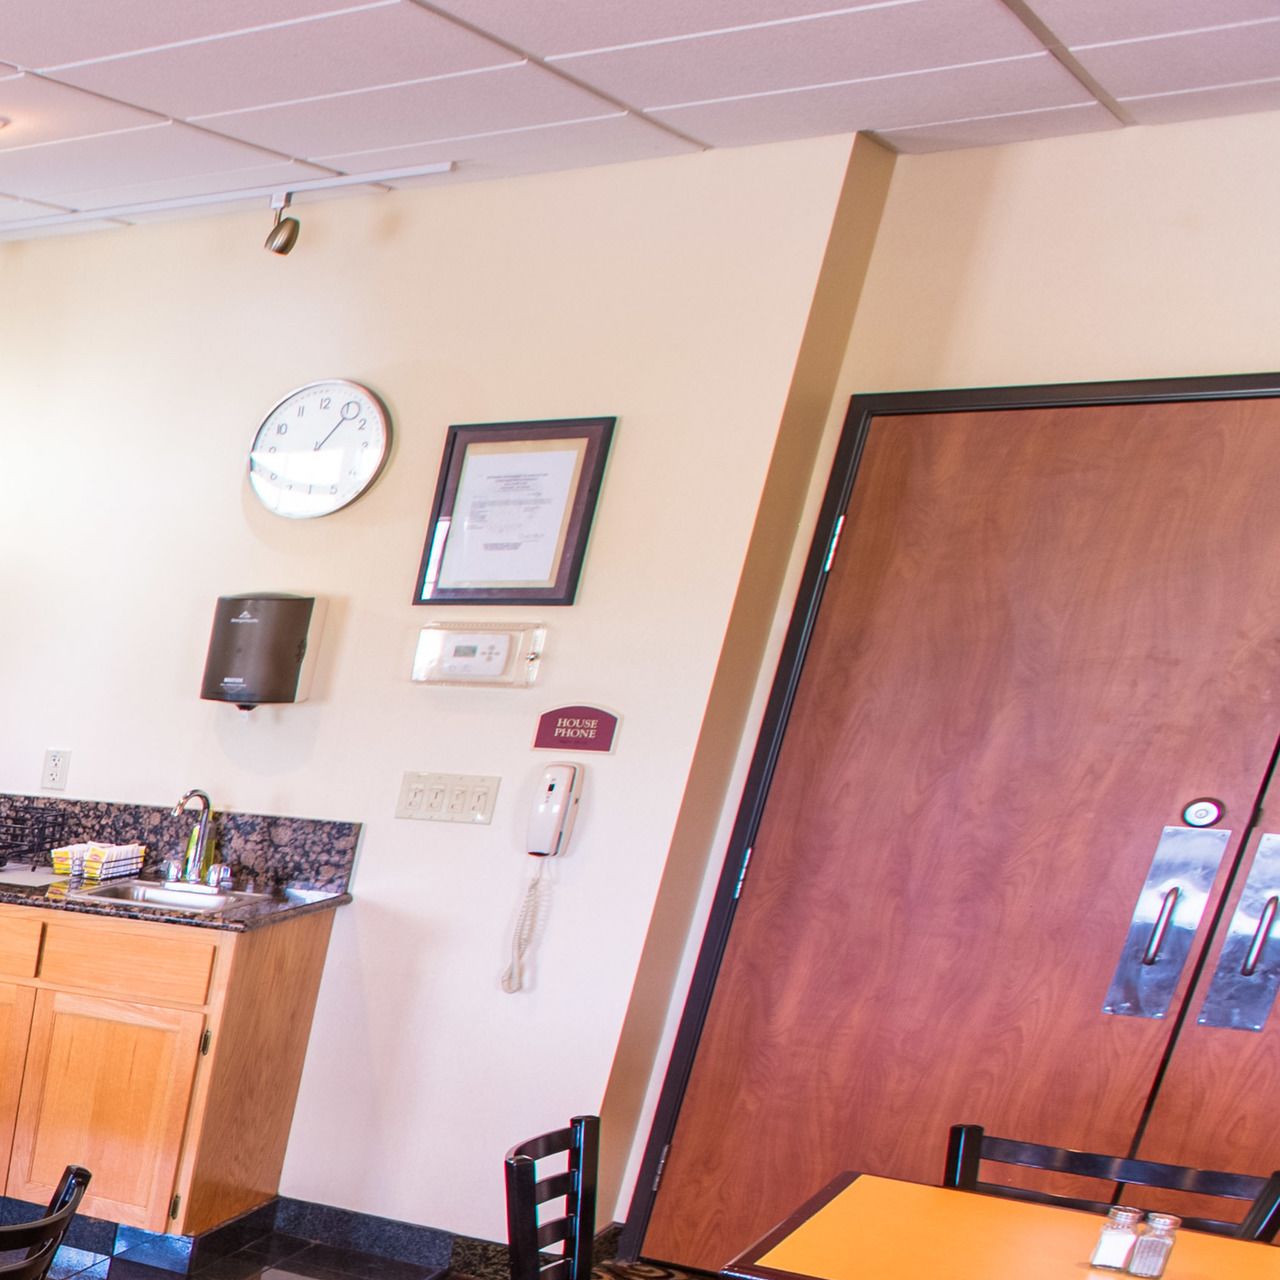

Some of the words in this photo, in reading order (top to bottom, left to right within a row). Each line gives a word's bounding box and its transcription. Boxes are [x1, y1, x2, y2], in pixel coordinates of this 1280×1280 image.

[320, 398, 331, 410] 12
[297, 405, 305, 417] 11
[276, 423, 288, 436] 10
[358, 418, 367, 431] 2
[556, 718, 599, 729] HOUSE
[554, 727, 597, 739] PHONE
